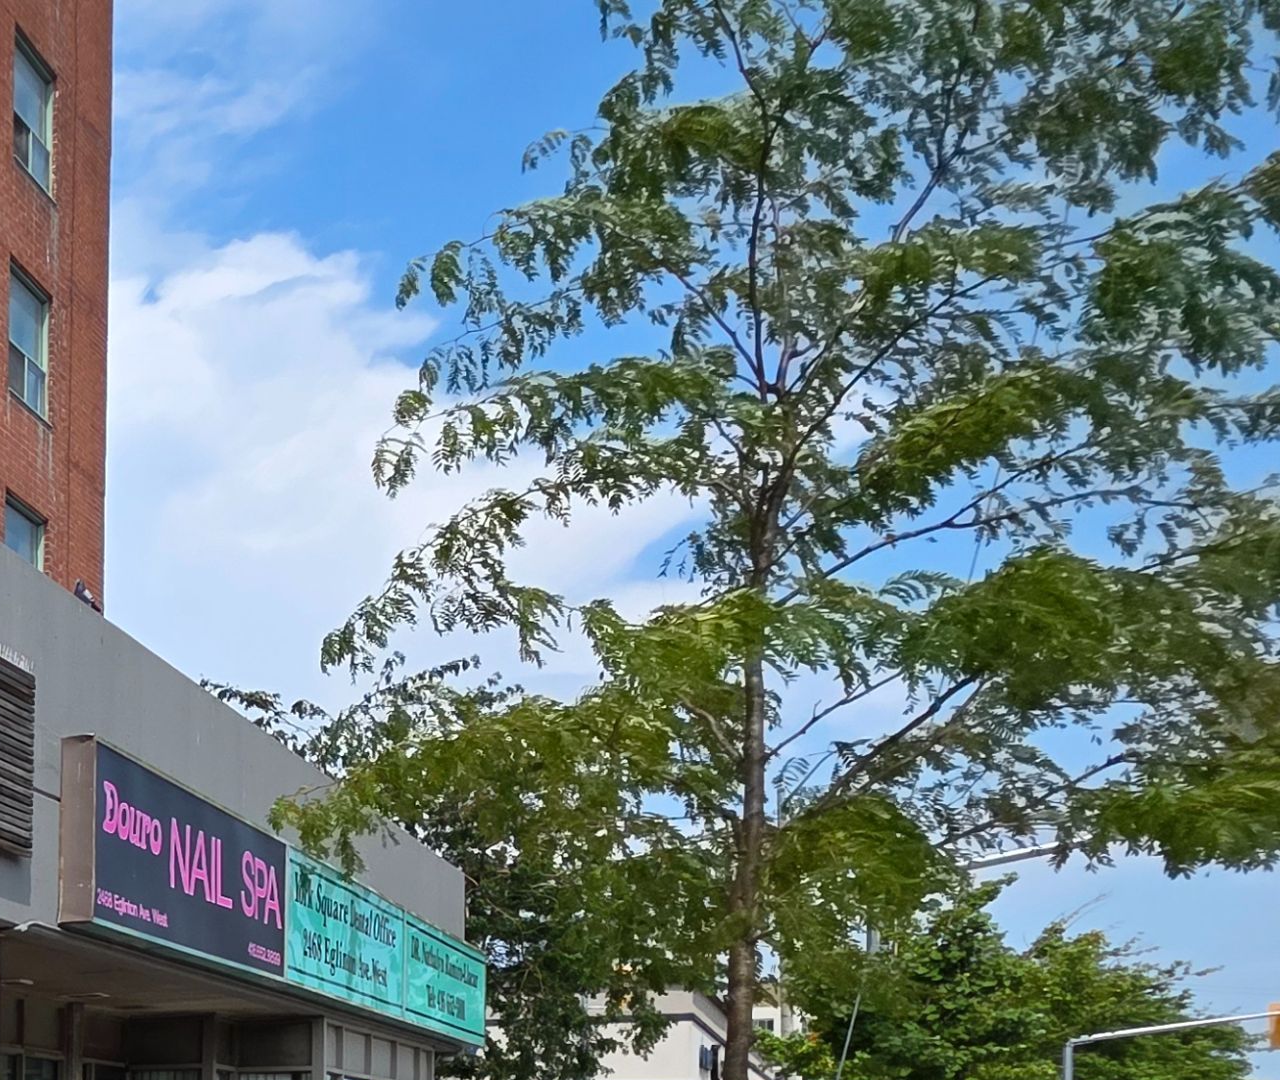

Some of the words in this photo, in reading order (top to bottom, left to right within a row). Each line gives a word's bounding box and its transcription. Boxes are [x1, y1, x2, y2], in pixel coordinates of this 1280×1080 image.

[102, 780, 162, 856] Douro
[169, 817, 233, 909] NAIL
[241, 851, 283, 930] SPA
[303, 928, 322, 963] 2468
[316, 882, 349, 927] Square
[350, 899, 372, 937] Dental
[373, 913, 397, 949] Office
